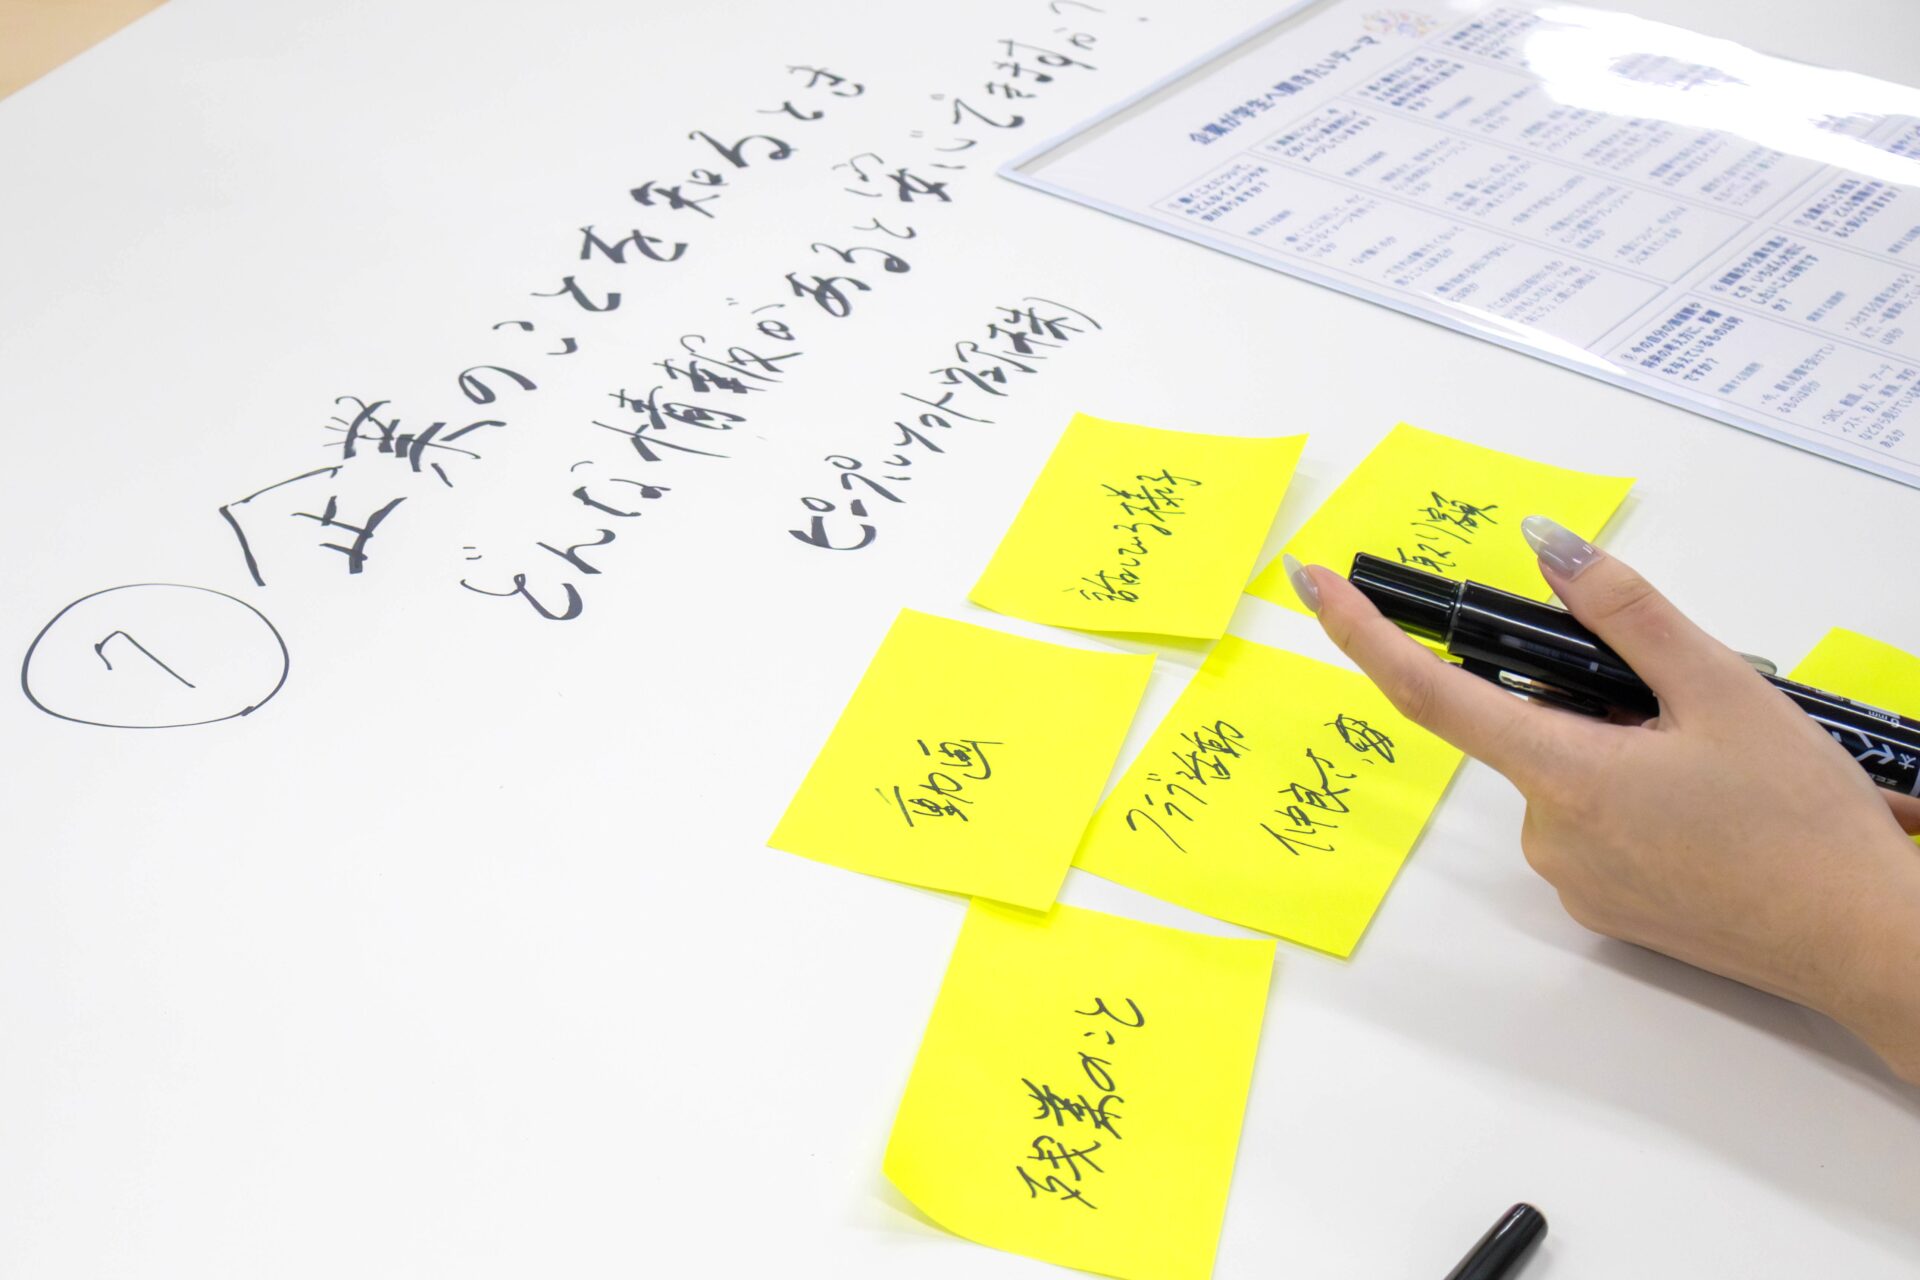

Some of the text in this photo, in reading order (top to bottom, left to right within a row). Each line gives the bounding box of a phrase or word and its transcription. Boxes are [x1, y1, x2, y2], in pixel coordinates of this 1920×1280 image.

[1189, 36, 1377, 144] 企業が学生へ聞きたいテーマ
[219, 64, 866, 586] 企業のことを知るとき
[1661, 316, 1744, 375] を与えているものは何
[1682, 358, 1719, 381] ですか？
[876, 739, 1004, 827] 動画
[1015, 997, 1145, 1209] 残業のこと
